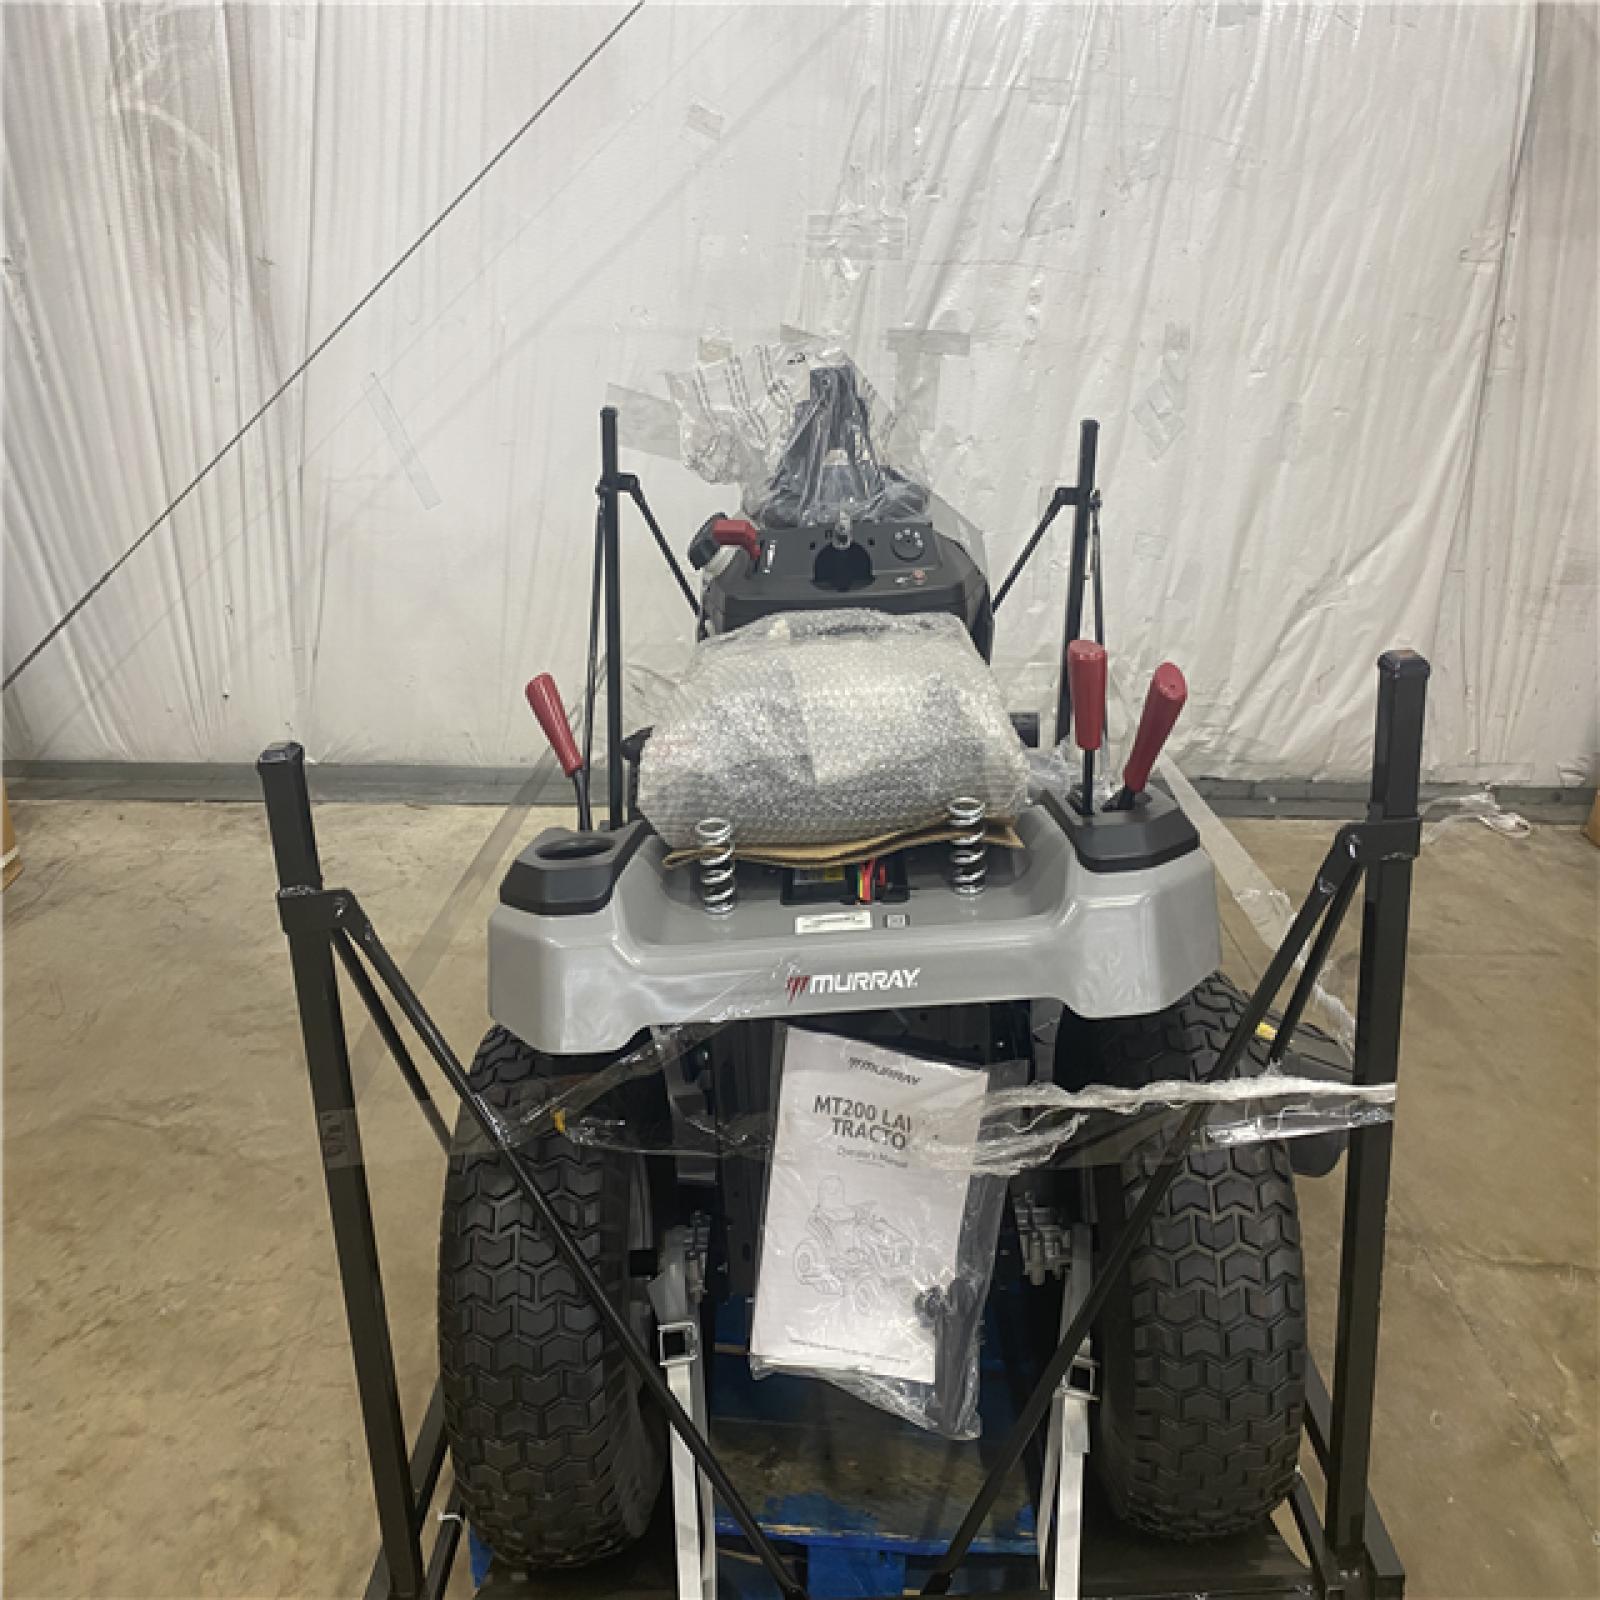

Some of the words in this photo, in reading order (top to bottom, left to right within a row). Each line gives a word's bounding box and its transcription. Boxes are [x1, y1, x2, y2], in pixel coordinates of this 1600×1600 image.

[810, 968, 921, 994] MURRAY
[814, 1094, 876, 1121] MT200
[832, 1116, 907, 1151] TRACTO
